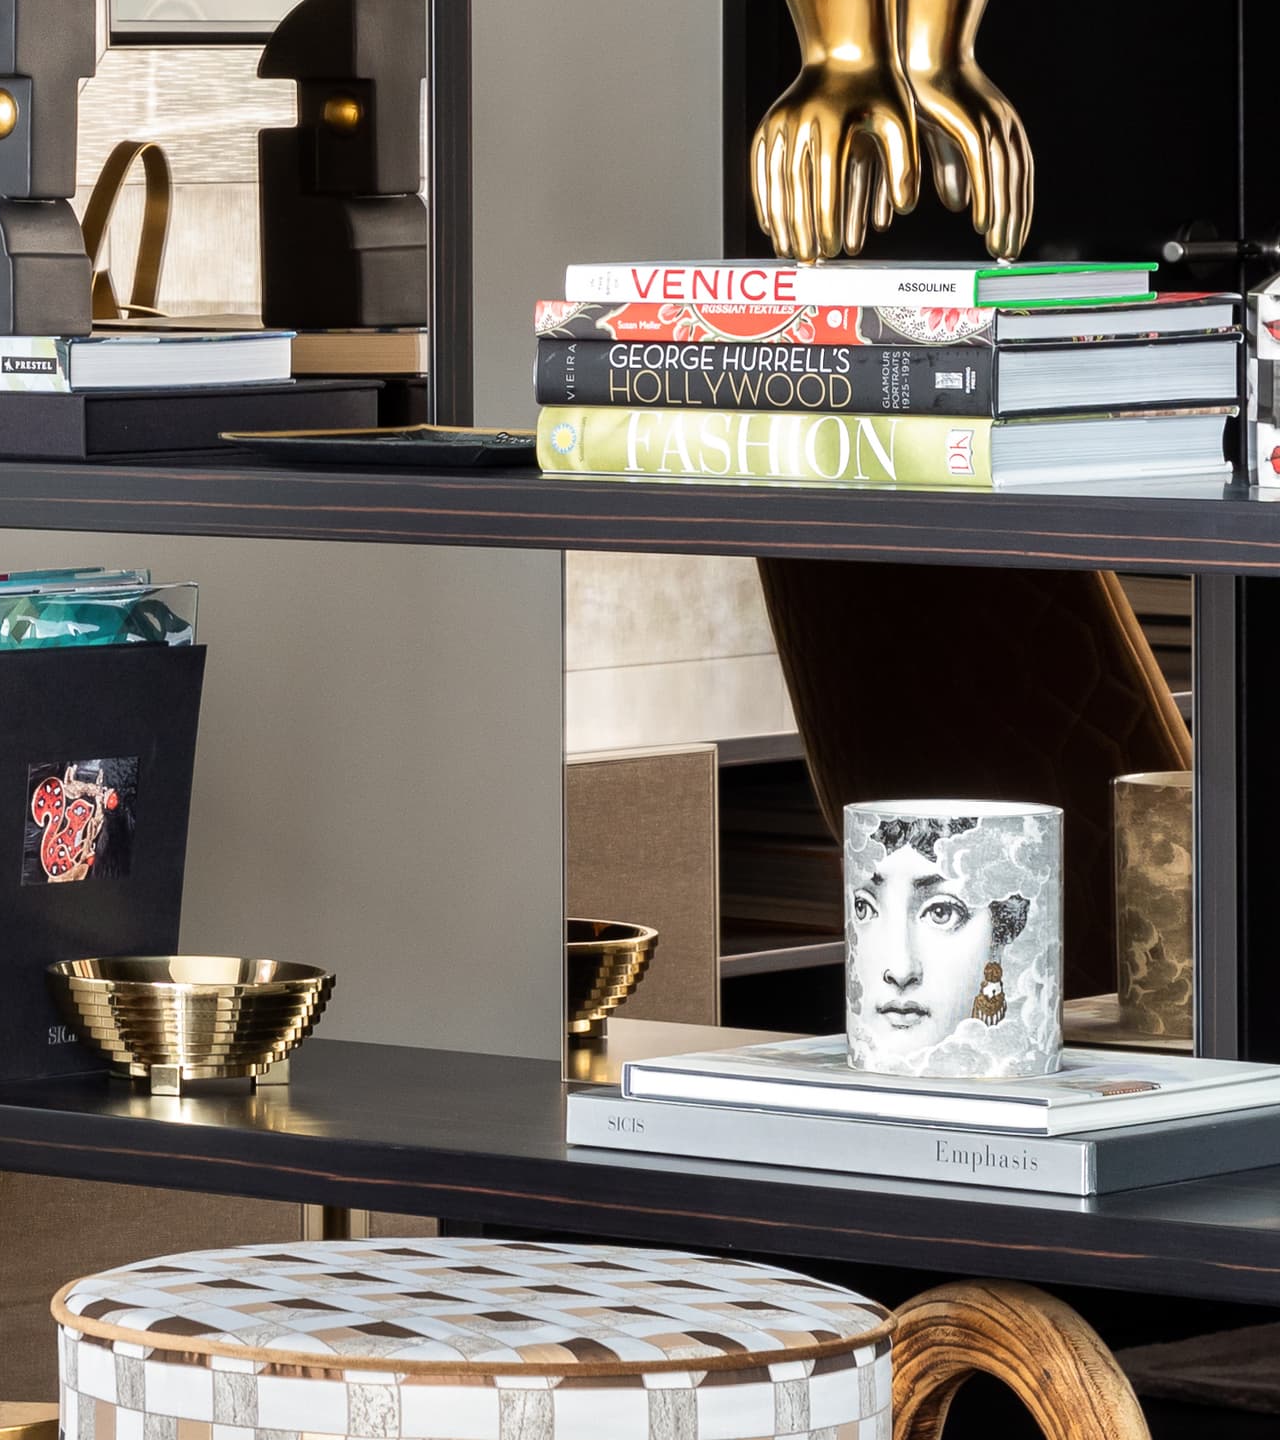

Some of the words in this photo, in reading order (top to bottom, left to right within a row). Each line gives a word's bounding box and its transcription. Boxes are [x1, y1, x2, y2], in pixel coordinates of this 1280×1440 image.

[631, 268, 798, 302] VENICE
[897, 282, 957, 293] ASSOULINE
[617, 320, 638, 330] Susan
[701, 303, 746, 314] RUSSIAN
[749, 304, 795, 315] TEXTILES
[14, 359, 54, 372] PRESTEL
[565, 343, 578, 401] VIEIRA
[609, 343, 716, 371] GEORGE
[722, 346, 851, 374] HURRELL'S
[608, 369, 853, 408] HOLLYWOOD
[882, 351, 891, 409] GLAMOUR
[892, 350, 902, 409] PORTRAITS
[902, 350, 912, 409] 1925-1992
[624, 410, 904, 481] FASHION
[948, 435, 970, 470] DK
[608, 1114, 646, 1134] SICIS
[935, 1139, 1040, 1174] Emphasis
